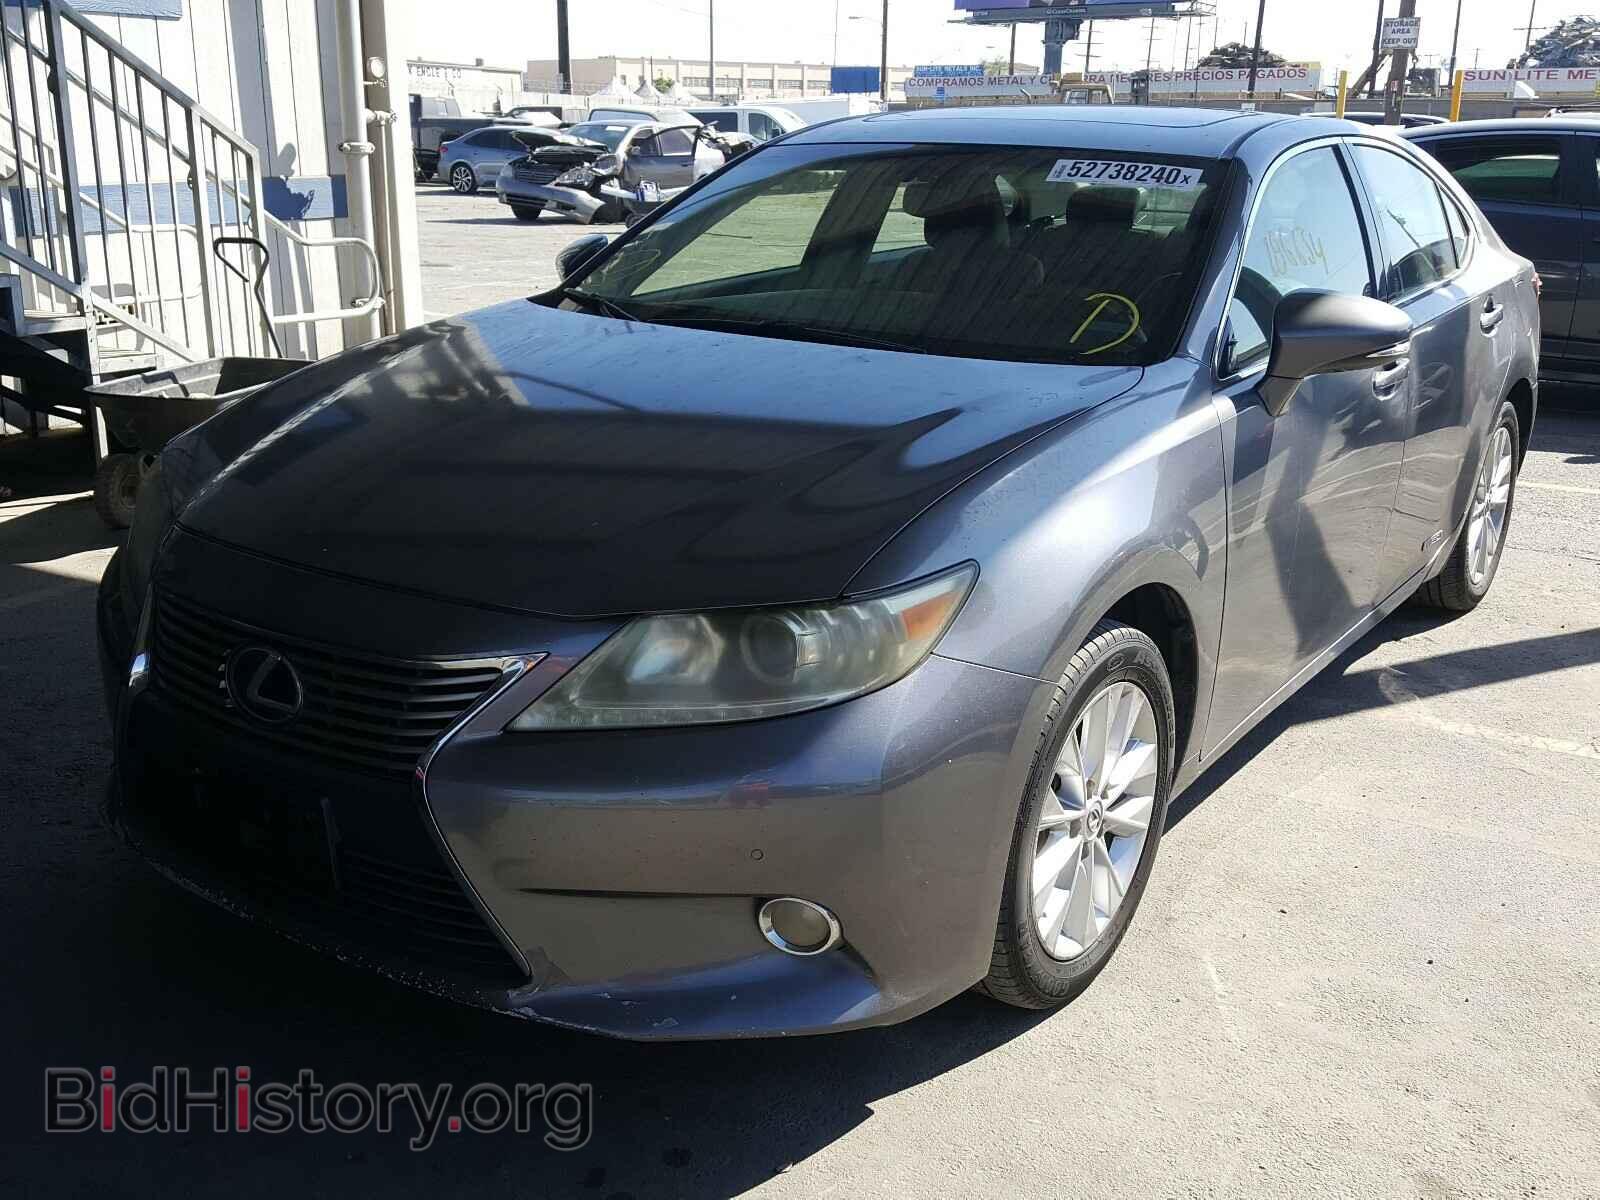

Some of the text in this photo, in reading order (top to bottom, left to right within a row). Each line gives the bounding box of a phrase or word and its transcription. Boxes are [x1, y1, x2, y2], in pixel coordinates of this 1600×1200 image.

[909, 77, 984, 87] COMPRAMOS
[988, 76, 1027, 86] METAL
[1029, 76, 1036, 84] Y
[1175, 70, 1234, 81] PRECIOS
[1238, 68, 1307, 79] PAGADOS
[1464, 69, 1600, 81] SUN LITE ME
